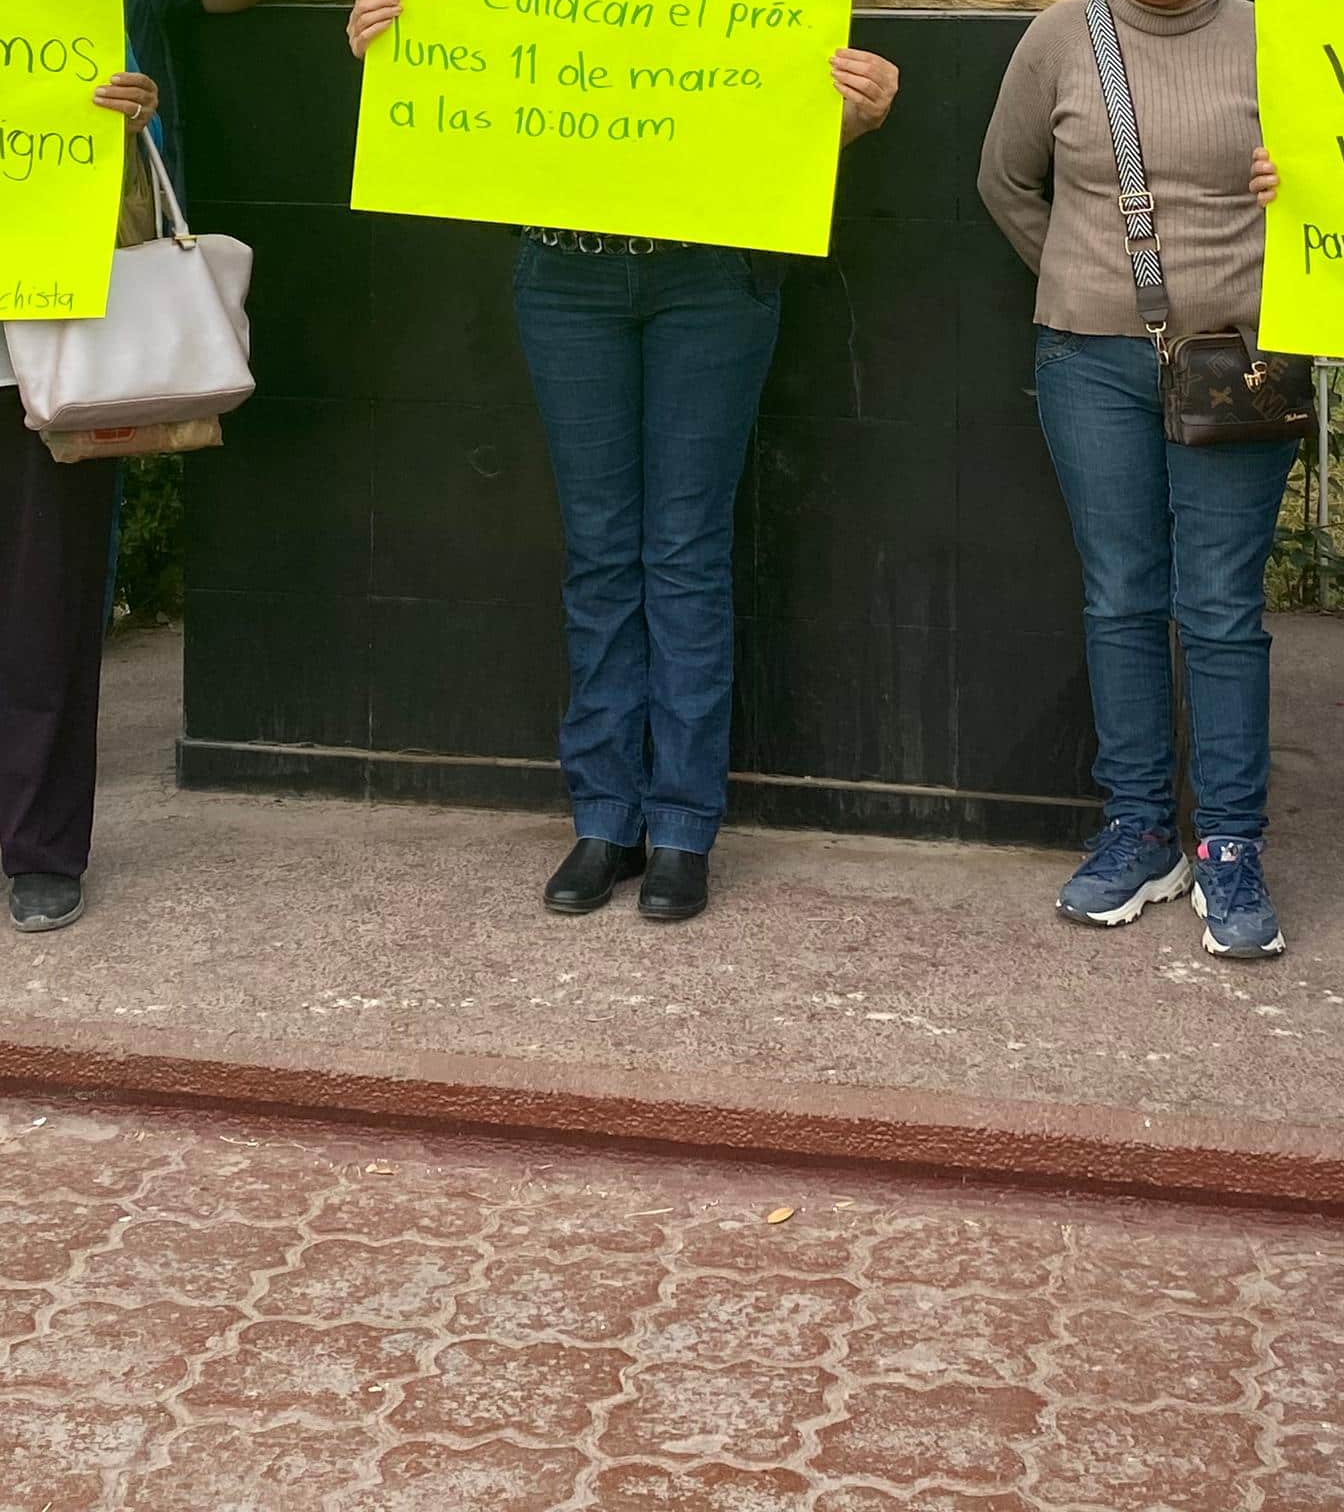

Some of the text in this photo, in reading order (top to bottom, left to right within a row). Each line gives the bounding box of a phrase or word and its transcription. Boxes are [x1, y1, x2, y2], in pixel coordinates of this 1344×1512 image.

[512, 44, 536, 84] 11
[558, 51, 608, 90] de
[390, 96, 675, 141] a las 10:00 am
